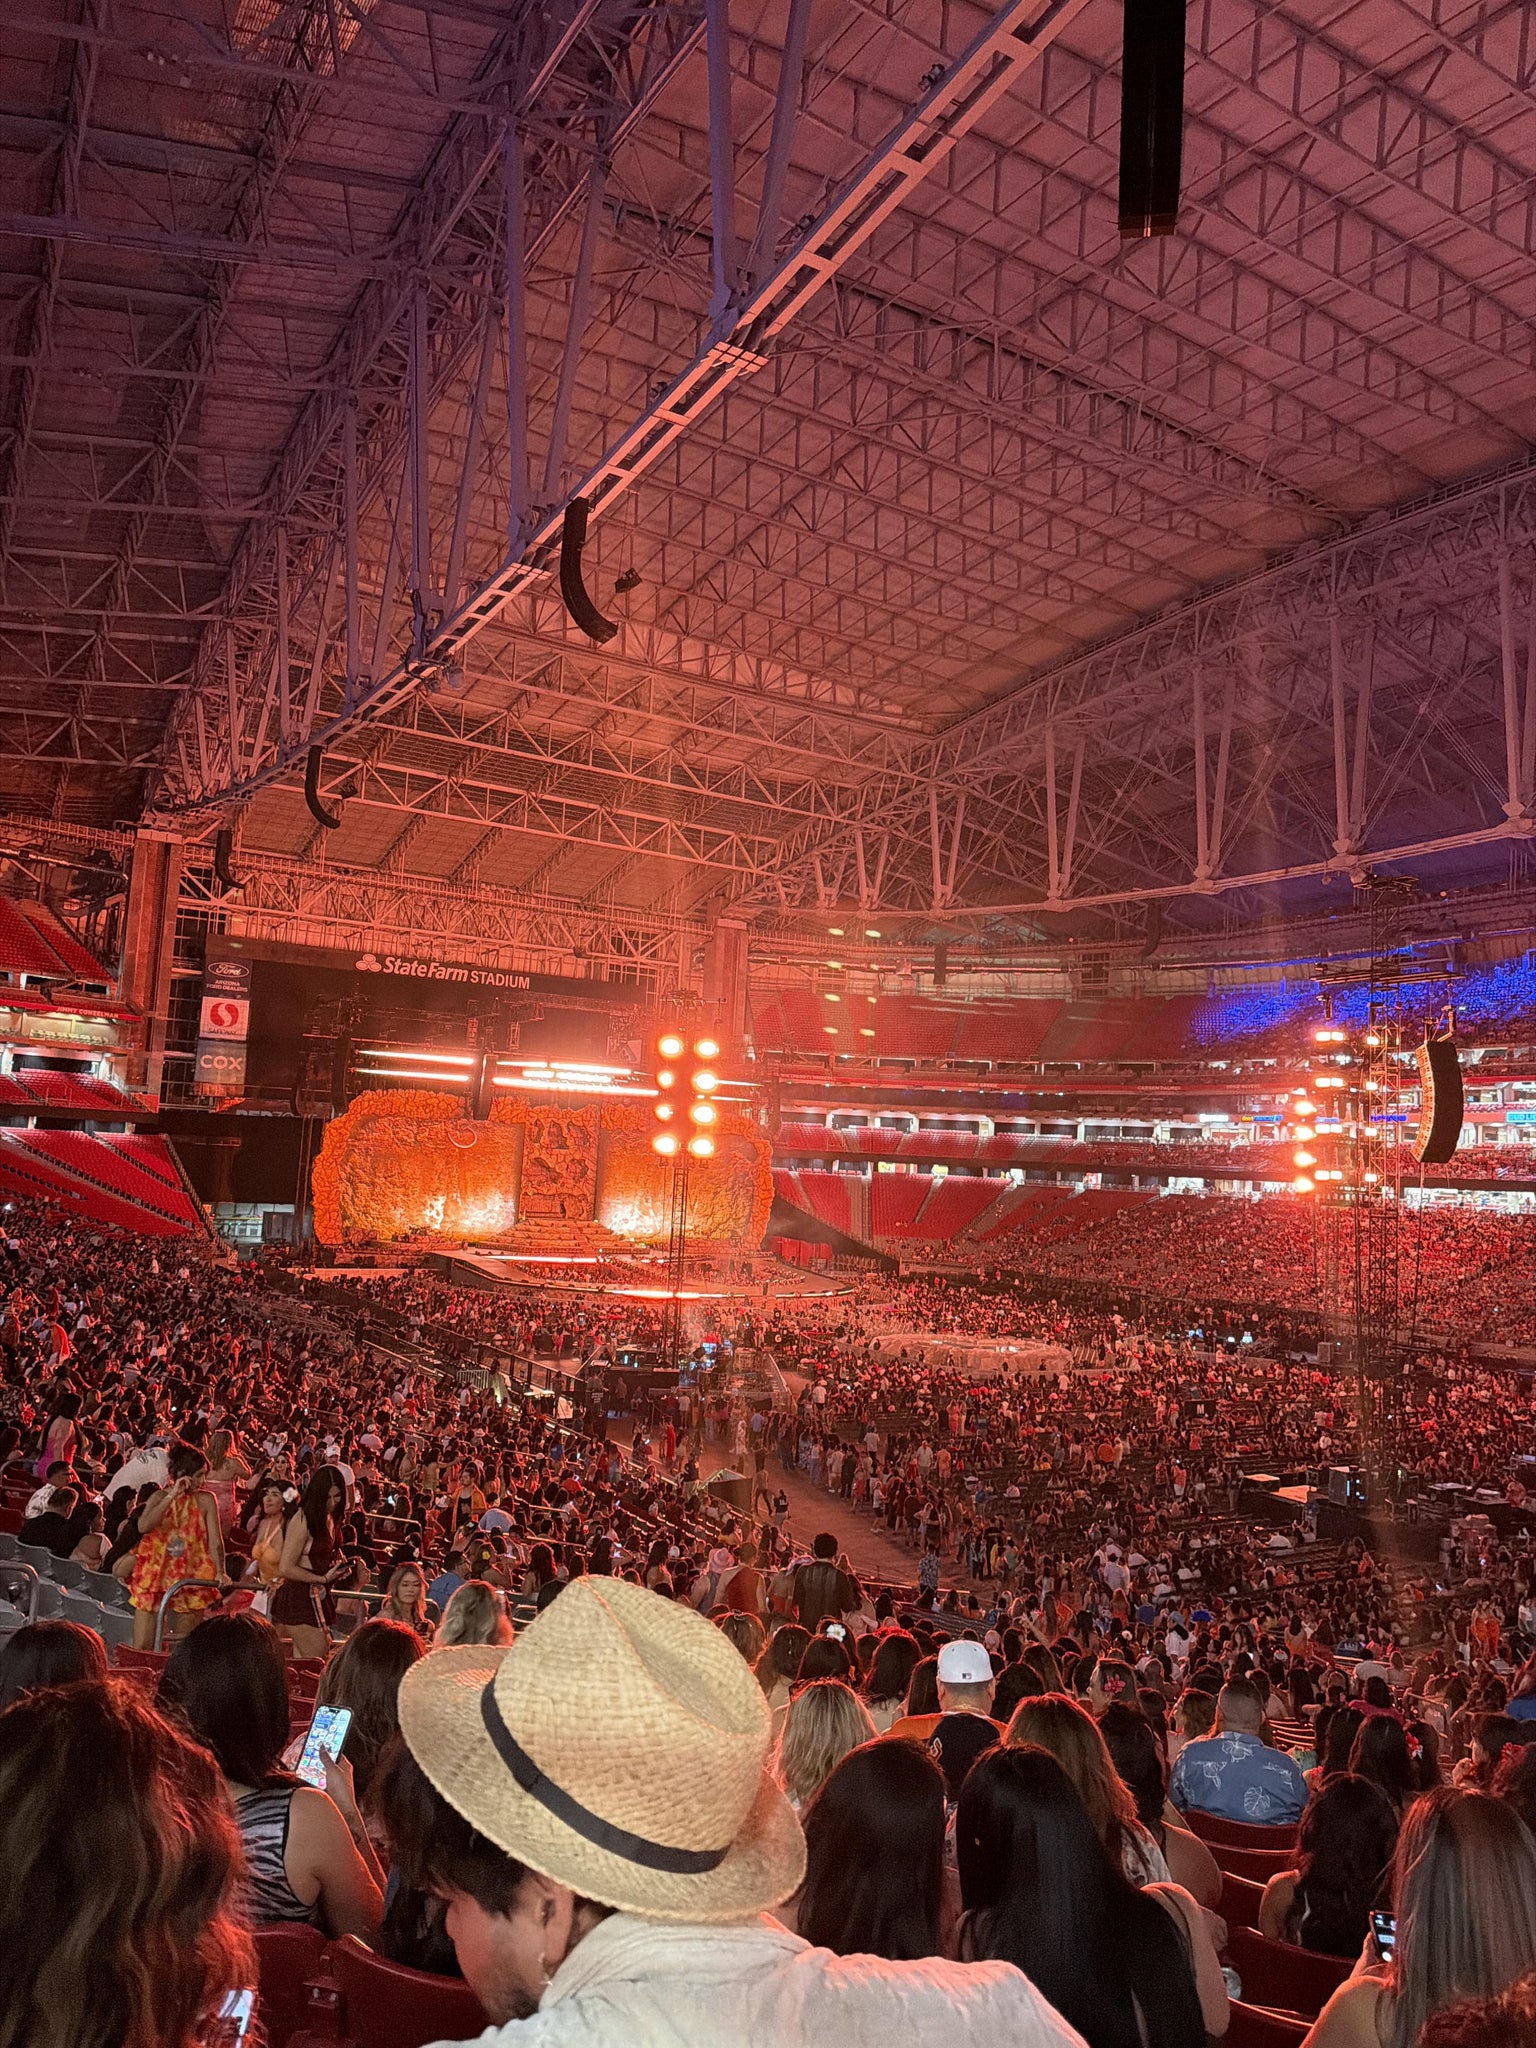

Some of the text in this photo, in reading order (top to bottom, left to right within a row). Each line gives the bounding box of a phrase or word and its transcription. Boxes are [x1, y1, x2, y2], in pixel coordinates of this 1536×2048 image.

[215, 963, 242, 976] Ford
[470, 970, 531, 990] STADIUM
[78, 1009, 119, 1018] CONZELMAN
[201, 1054, 242, 1071] COX
